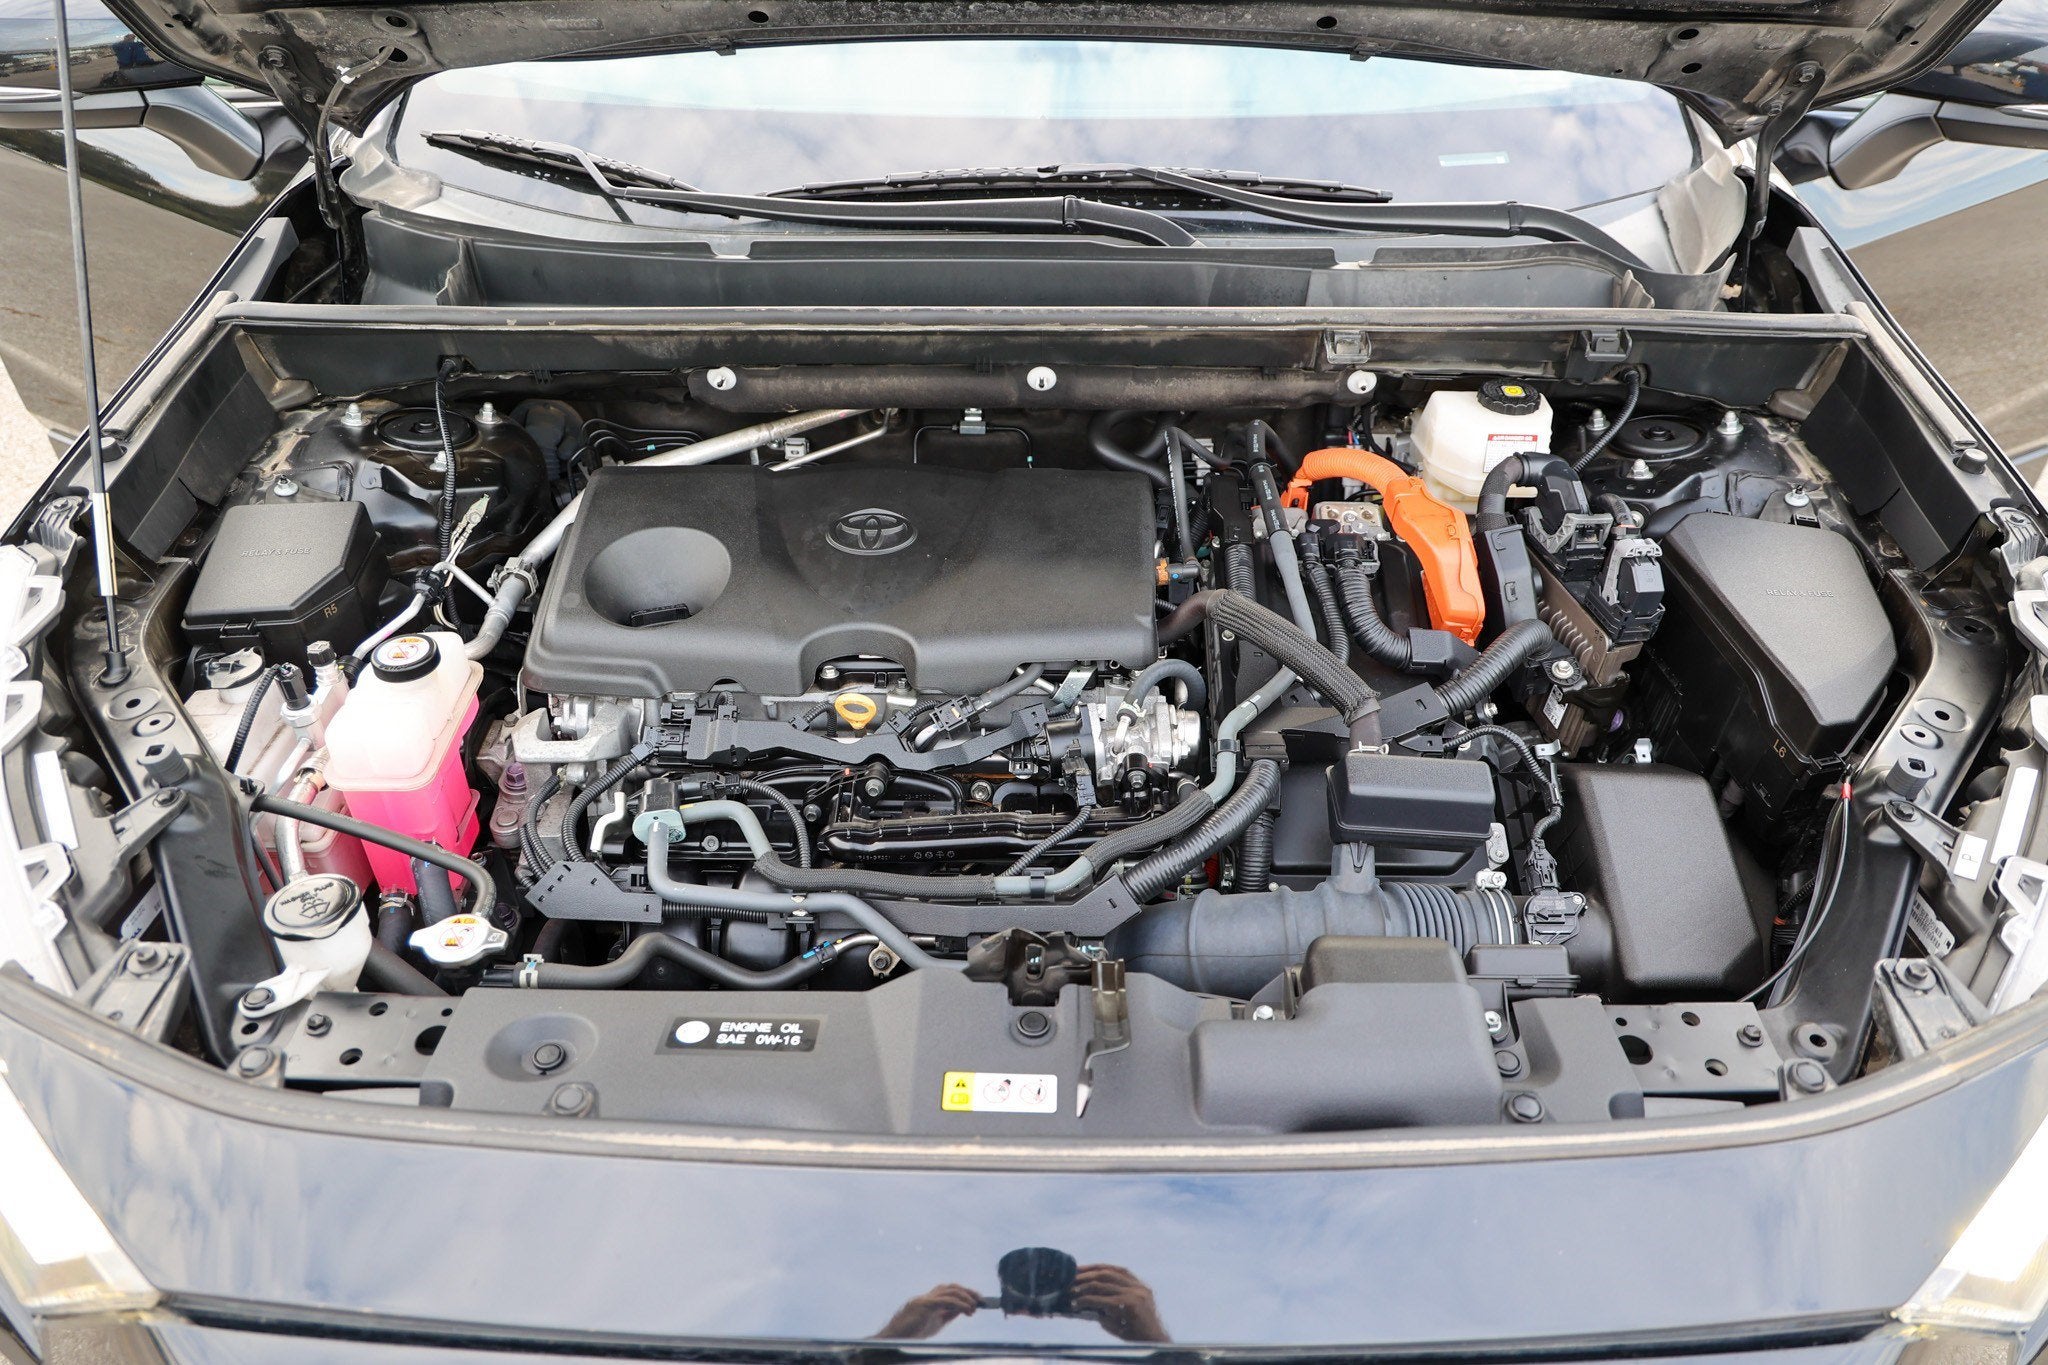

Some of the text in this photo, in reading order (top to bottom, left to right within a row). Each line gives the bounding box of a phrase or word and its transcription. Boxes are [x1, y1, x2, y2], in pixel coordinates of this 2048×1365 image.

[240, 548, 276, 559] RELAY
[285, 547, 312, 556] FUSE
[1766, 588, 1798, 597] RELAY
[1807, 590, 1834, 598] FUSE
[1773, 738, 1787, 758] L6
[719, 1021, 804, 1034] ENGINE OIL
[716, 1033, 801, 1046] SAE 0W-16
